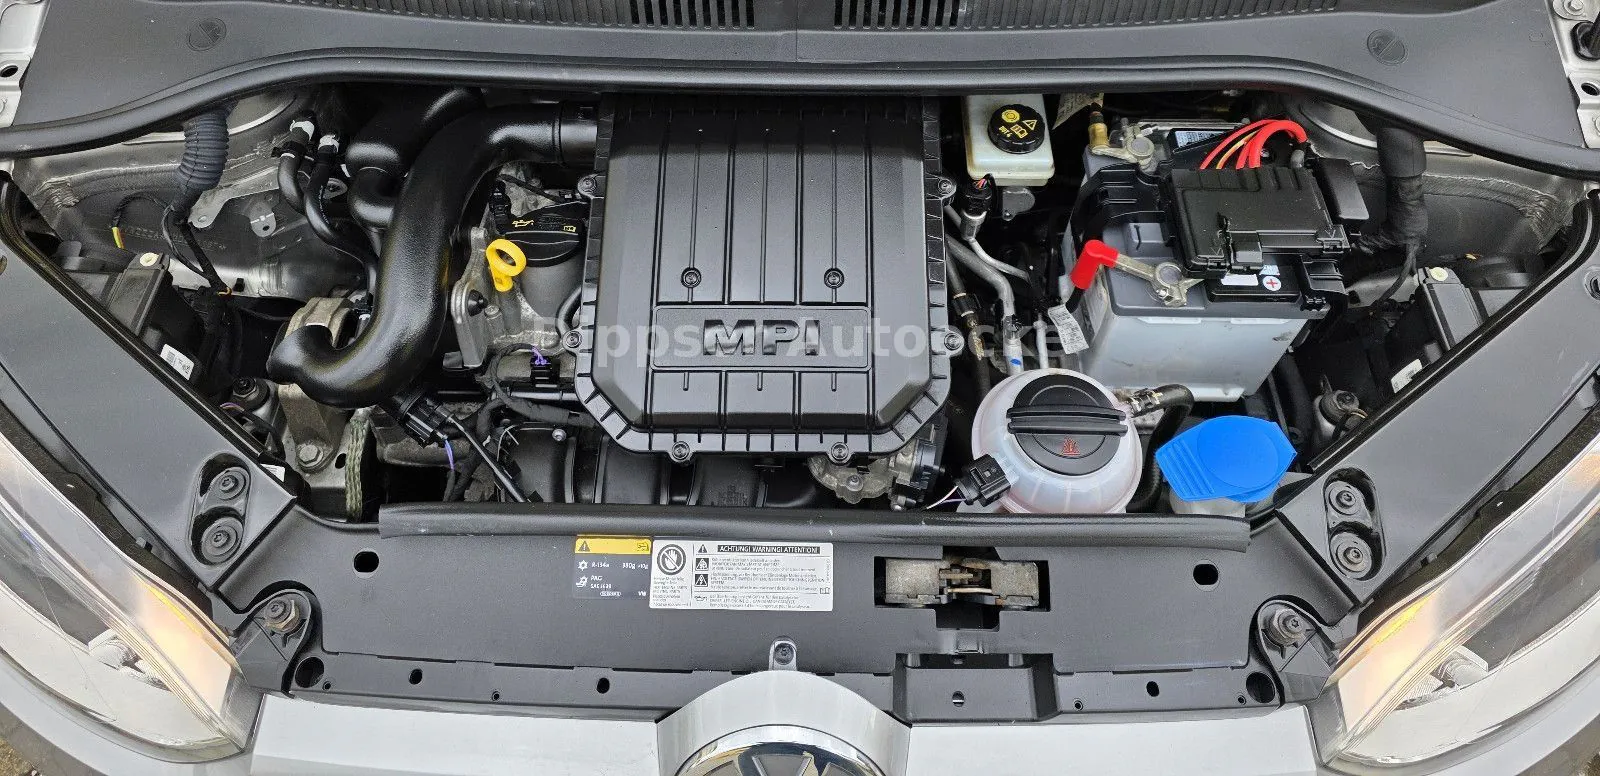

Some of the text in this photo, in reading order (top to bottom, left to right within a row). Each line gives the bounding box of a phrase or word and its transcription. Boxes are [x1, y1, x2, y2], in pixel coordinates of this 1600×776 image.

[702, 319, 821, 356] MPI
[719, 545, 751, 553] ACHTUNG!
[783, 546, 818, 554] ATTENTION!
